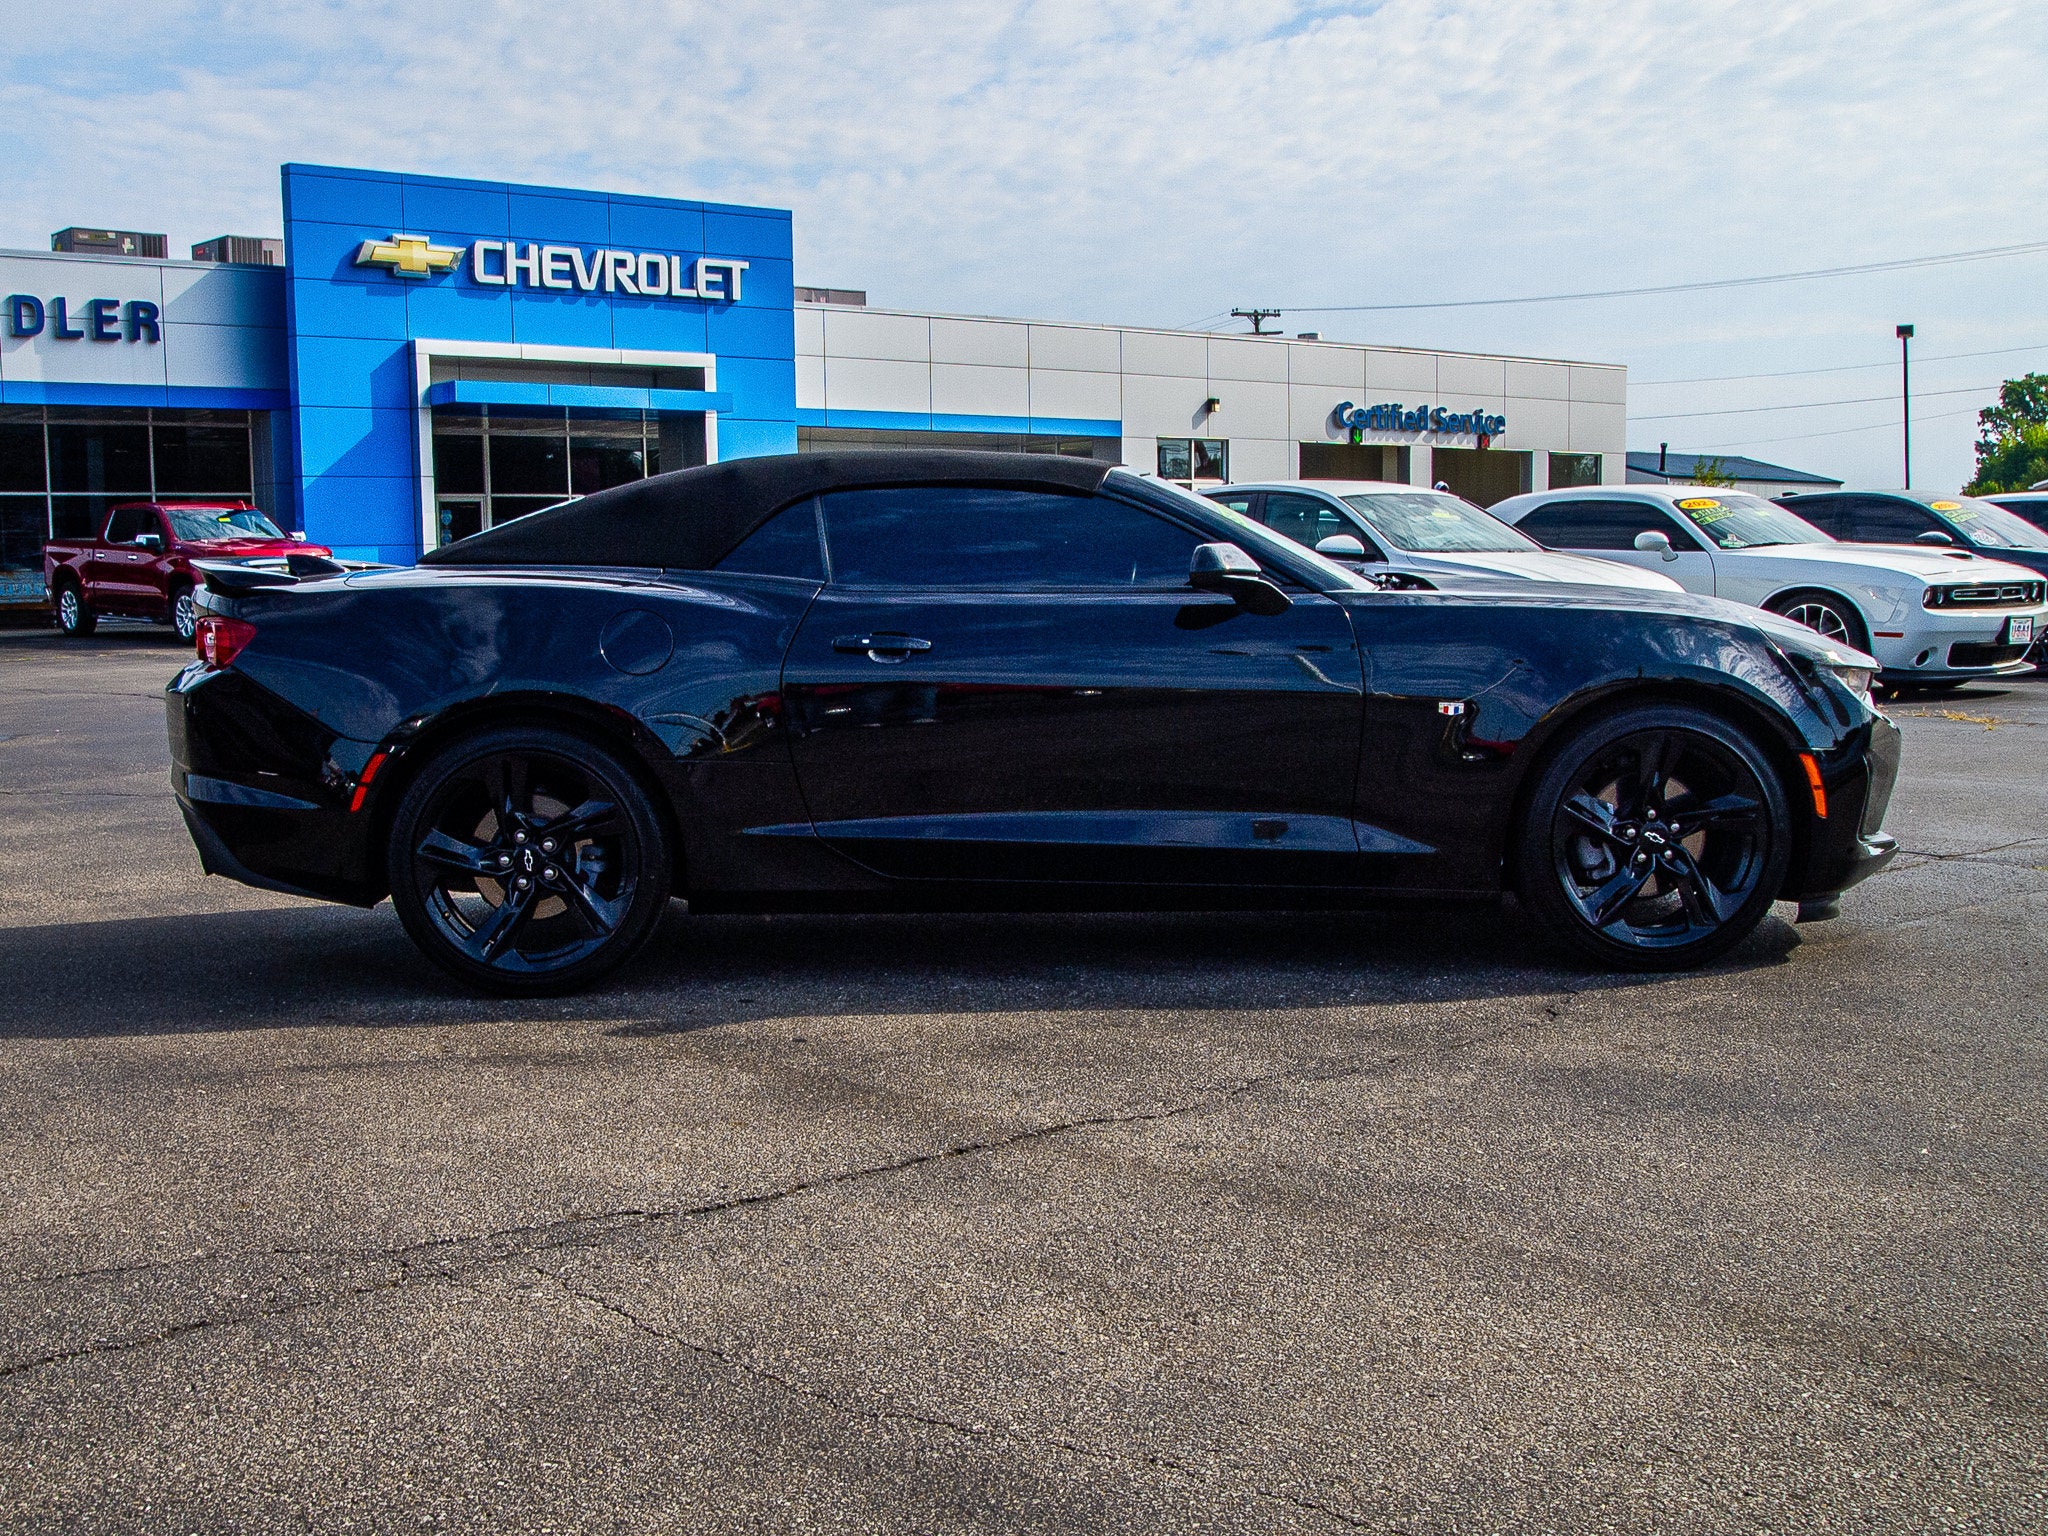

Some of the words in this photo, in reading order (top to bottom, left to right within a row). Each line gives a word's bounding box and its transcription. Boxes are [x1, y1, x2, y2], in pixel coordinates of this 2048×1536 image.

[474, 239, 750, 301] CHEVROLET
[8, 294, 161, 343] DLER
[1335, 401, 1429, 431] Certified
[1433, 406, 1506, 435] Service
